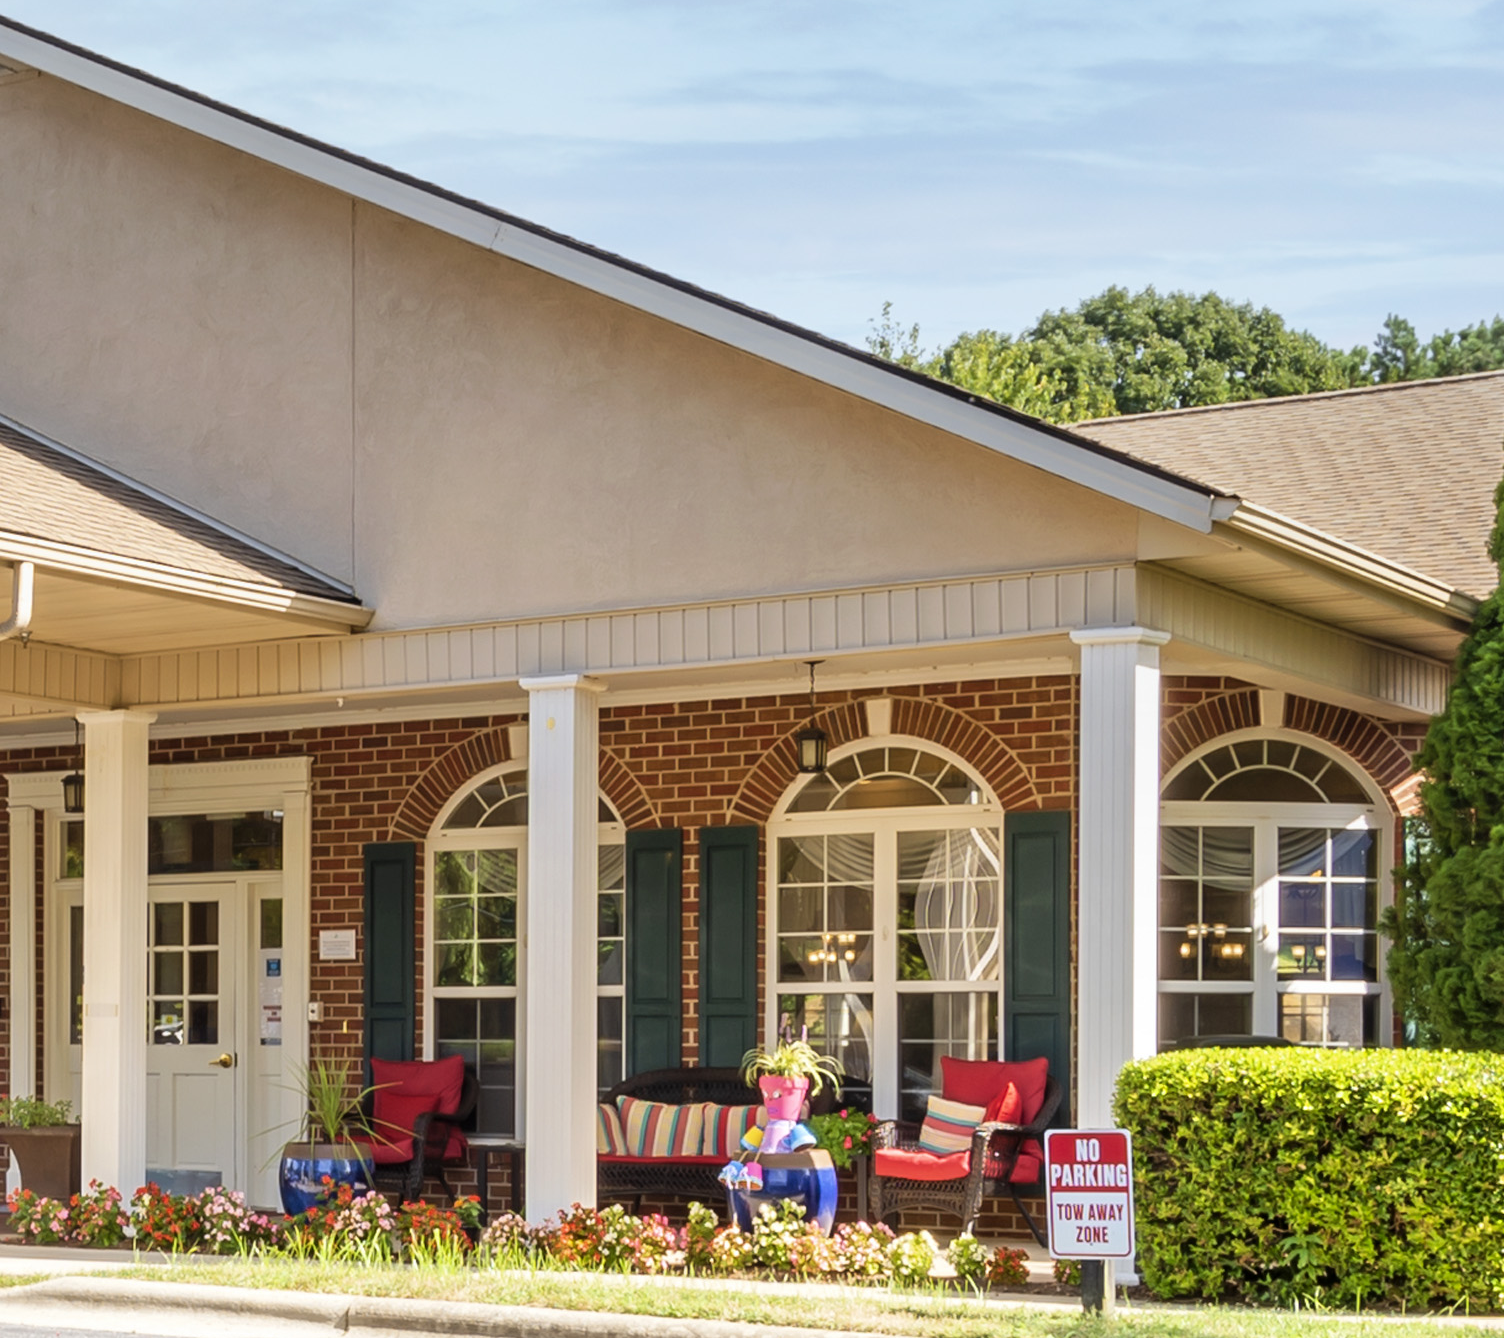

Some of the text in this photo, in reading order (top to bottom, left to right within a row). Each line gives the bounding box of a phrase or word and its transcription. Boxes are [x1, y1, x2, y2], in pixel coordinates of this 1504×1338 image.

[1075, 1138, 1100, 1162] NO
[1050, 1164, 1128, 1187] PARKING
[1056, 1204, 1124, 1221] TOW AWAY
[1076, 1226, 1109, 1243] ZONE
